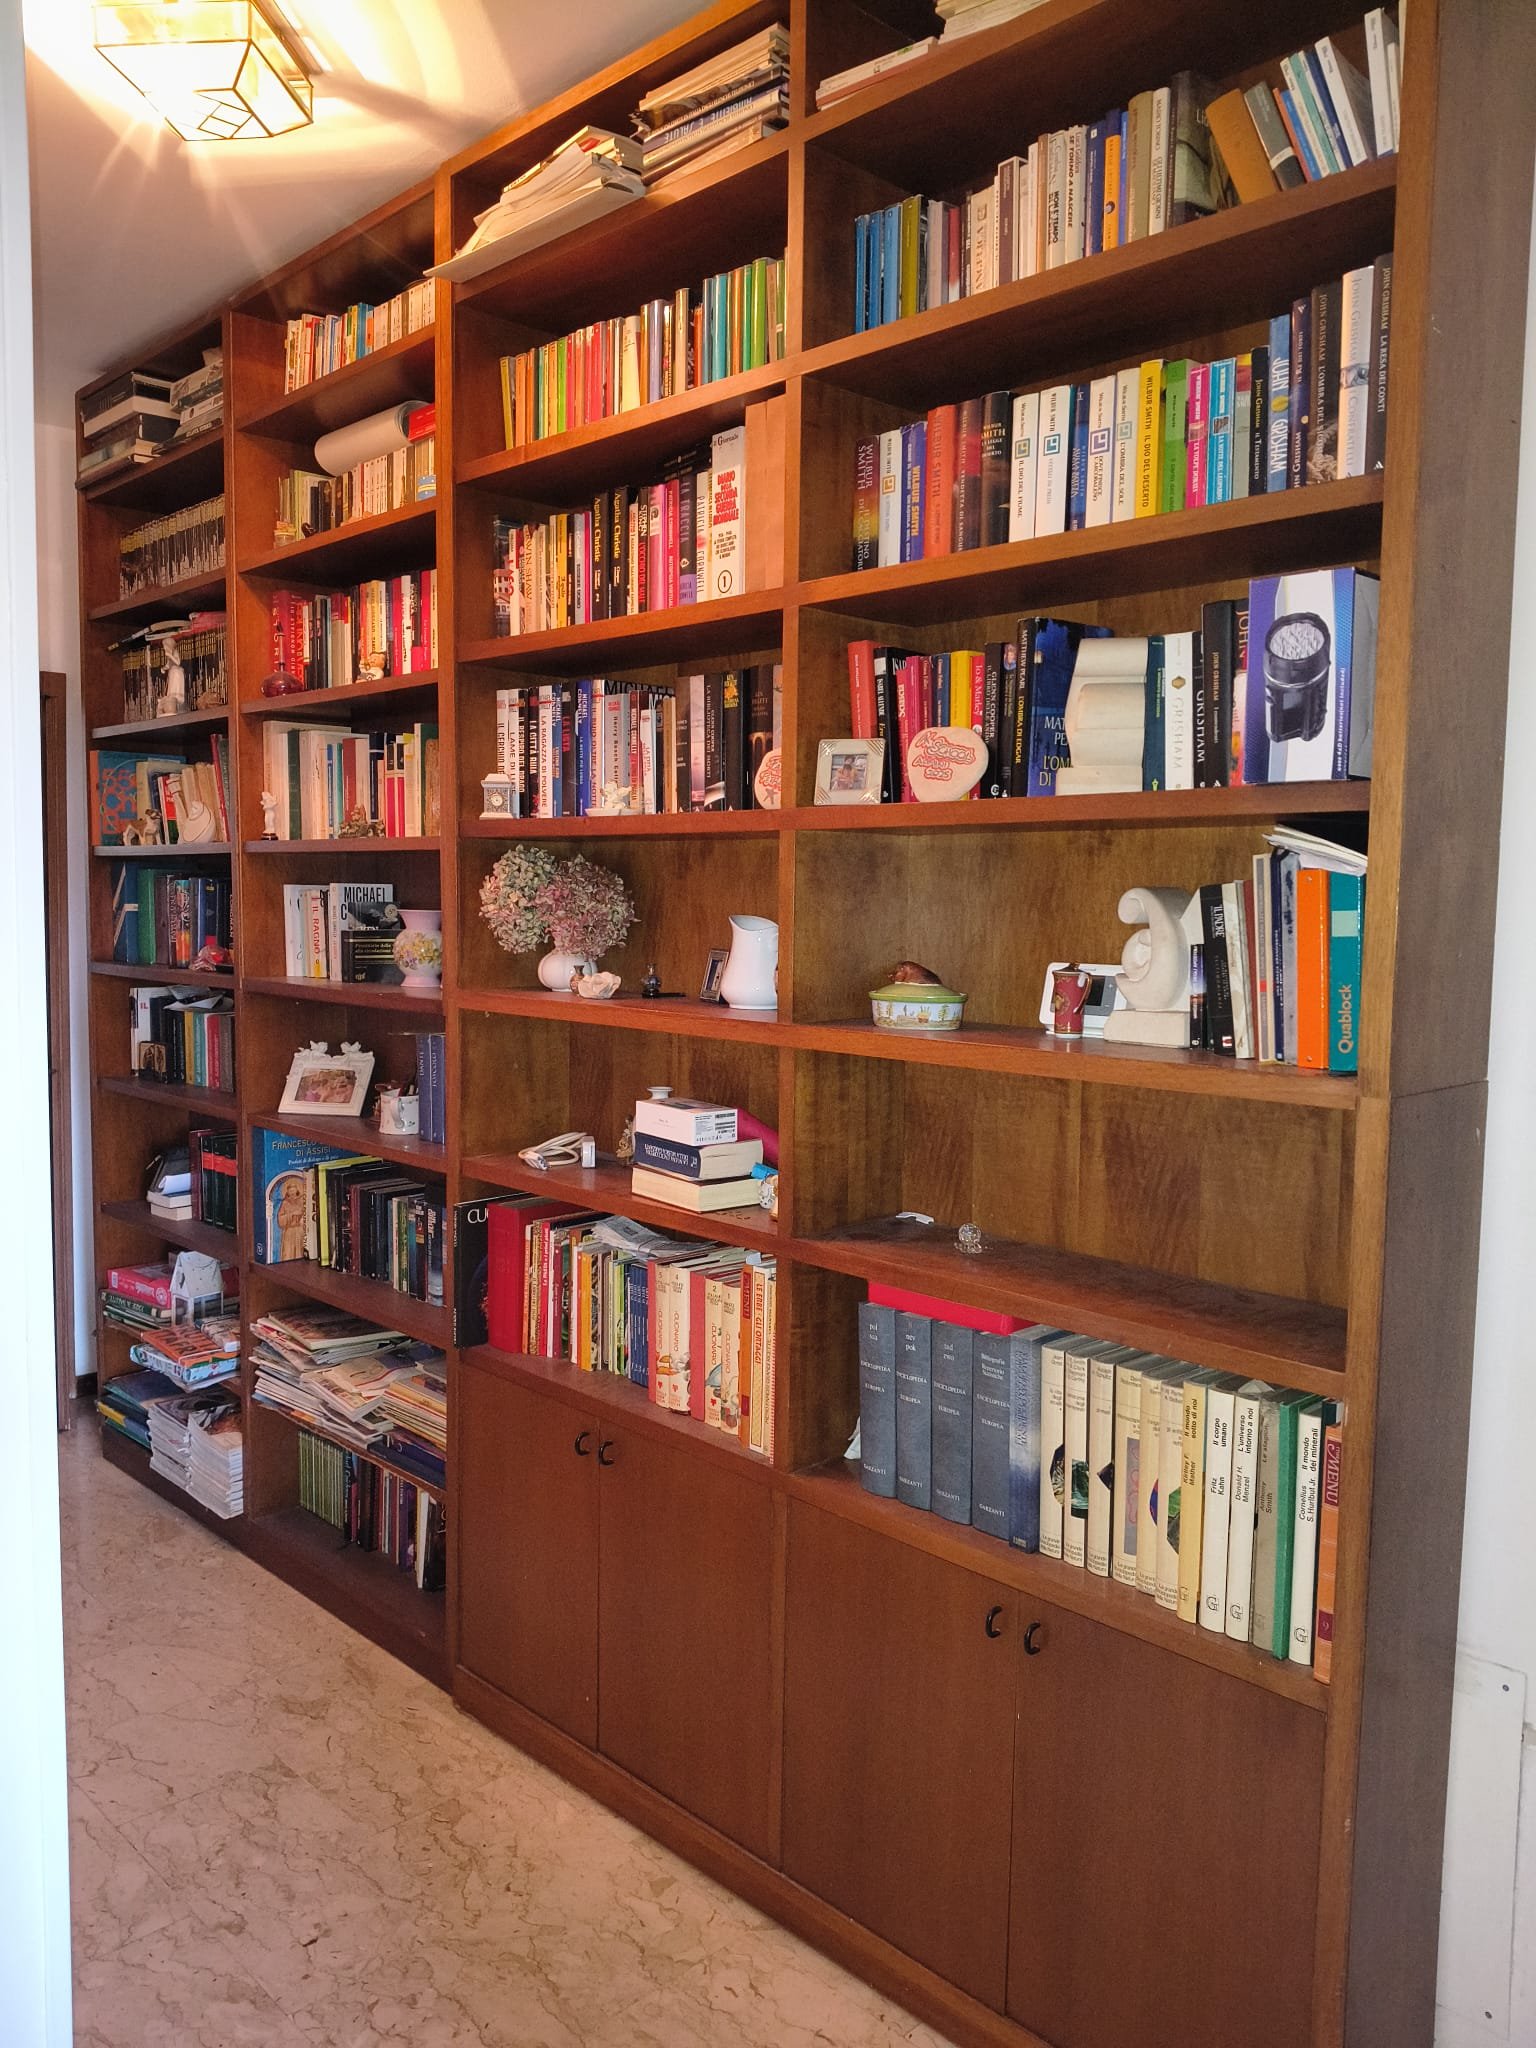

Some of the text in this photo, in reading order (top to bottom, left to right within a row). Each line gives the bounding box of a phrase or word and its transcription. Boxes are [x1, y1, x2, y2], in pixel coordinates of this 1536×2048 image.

[1068, 136, 1074, 144] SE
[1382, 267, 1392, 289] JOHN
[1380, 291, 1390, 330] GRISHAM
[1318, 318, 1327, 361] GRISHAM
[1378, 348, 1388, 370] RESA
[1380, 334, 1388, 346] LA
[1254, 398, 1262, 428] GRISHAM
[1270, 357, 1289, 474] JOHN GRISHAM
[1377, 386, 1386, 413] CONTI
[1144, 434, 1151, 442] IL
[1292, 432, 1302, 472] GRISHAM
[857, 445, 866, 490] SMITH
[865, 444, 874, 488] WILBUR
[594, 497, 602, 527] Agatha
[910, 465, 920, 536] WILBUR SMITH
[613, 493, 622, 558] Agatha Christie
[680, 498, 691, 544] TRACCIA
[974, 684, 982, 716] Marley
[530, 720, 537, 730] LA
[1172, 696, 1184, 769] GRISHAM
[1338, 984, 1354, 1054] Quablock
[756, 1284, 762, 1292] LE
[1326, 1444, 1340, 1504] MENU
